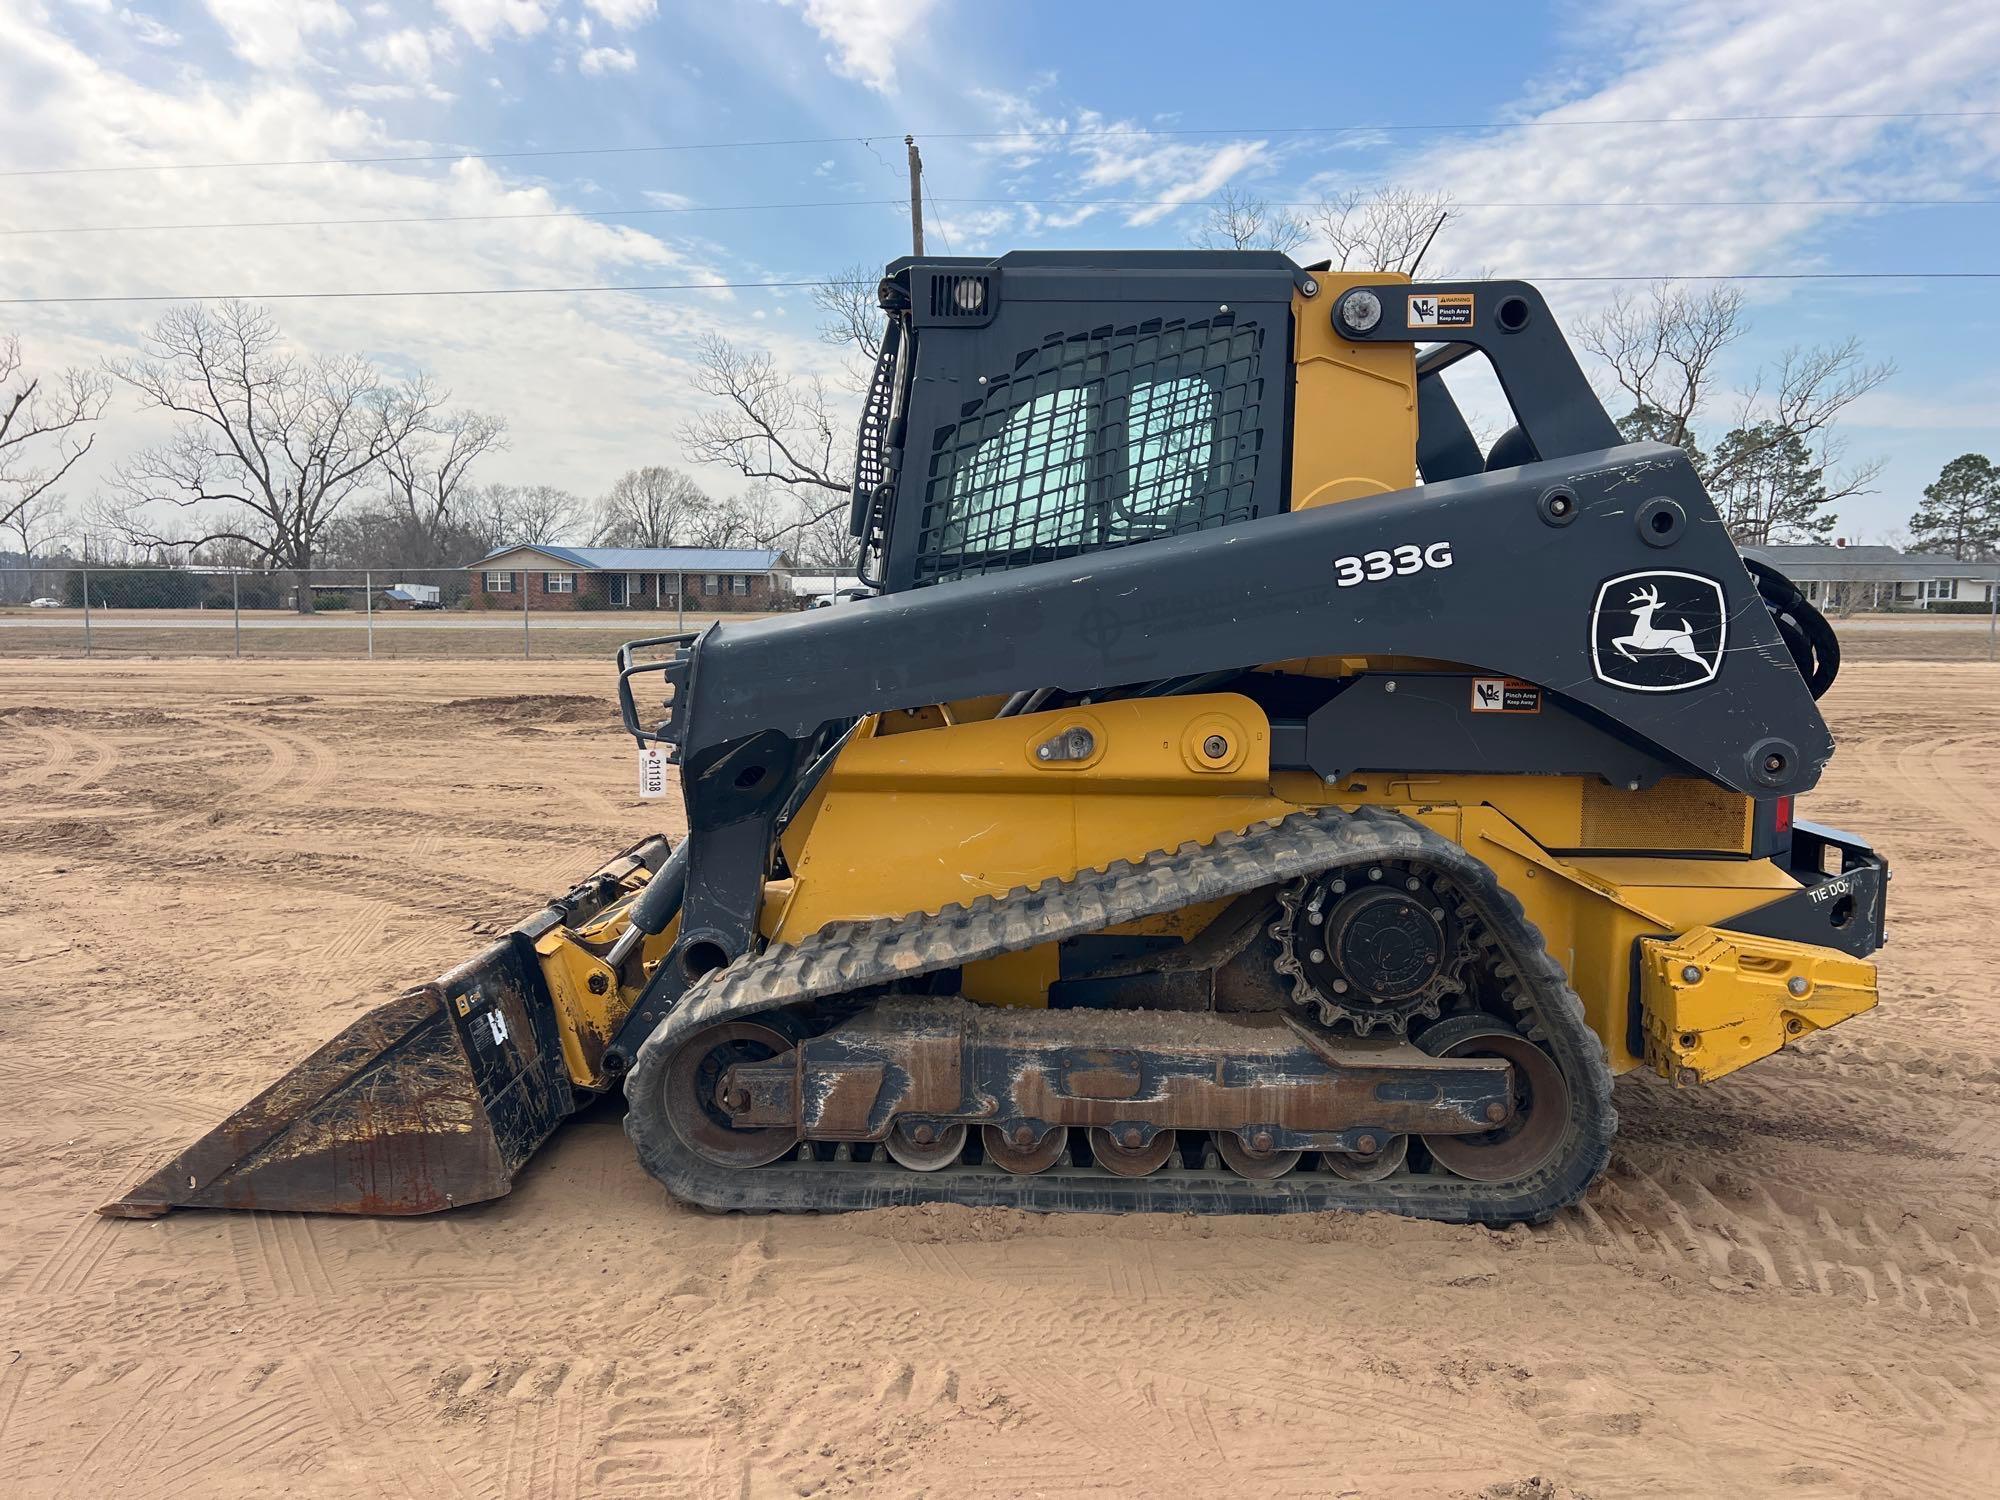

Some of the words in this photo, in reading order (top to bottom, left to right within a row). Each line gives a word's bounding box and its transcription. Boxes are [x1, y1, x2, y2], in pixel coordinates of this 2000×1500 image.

[1334, 541, 1453, 587] 333G
[648, 759, 661, 792] 211138
[1809, 887, 1829, 903] TIE
